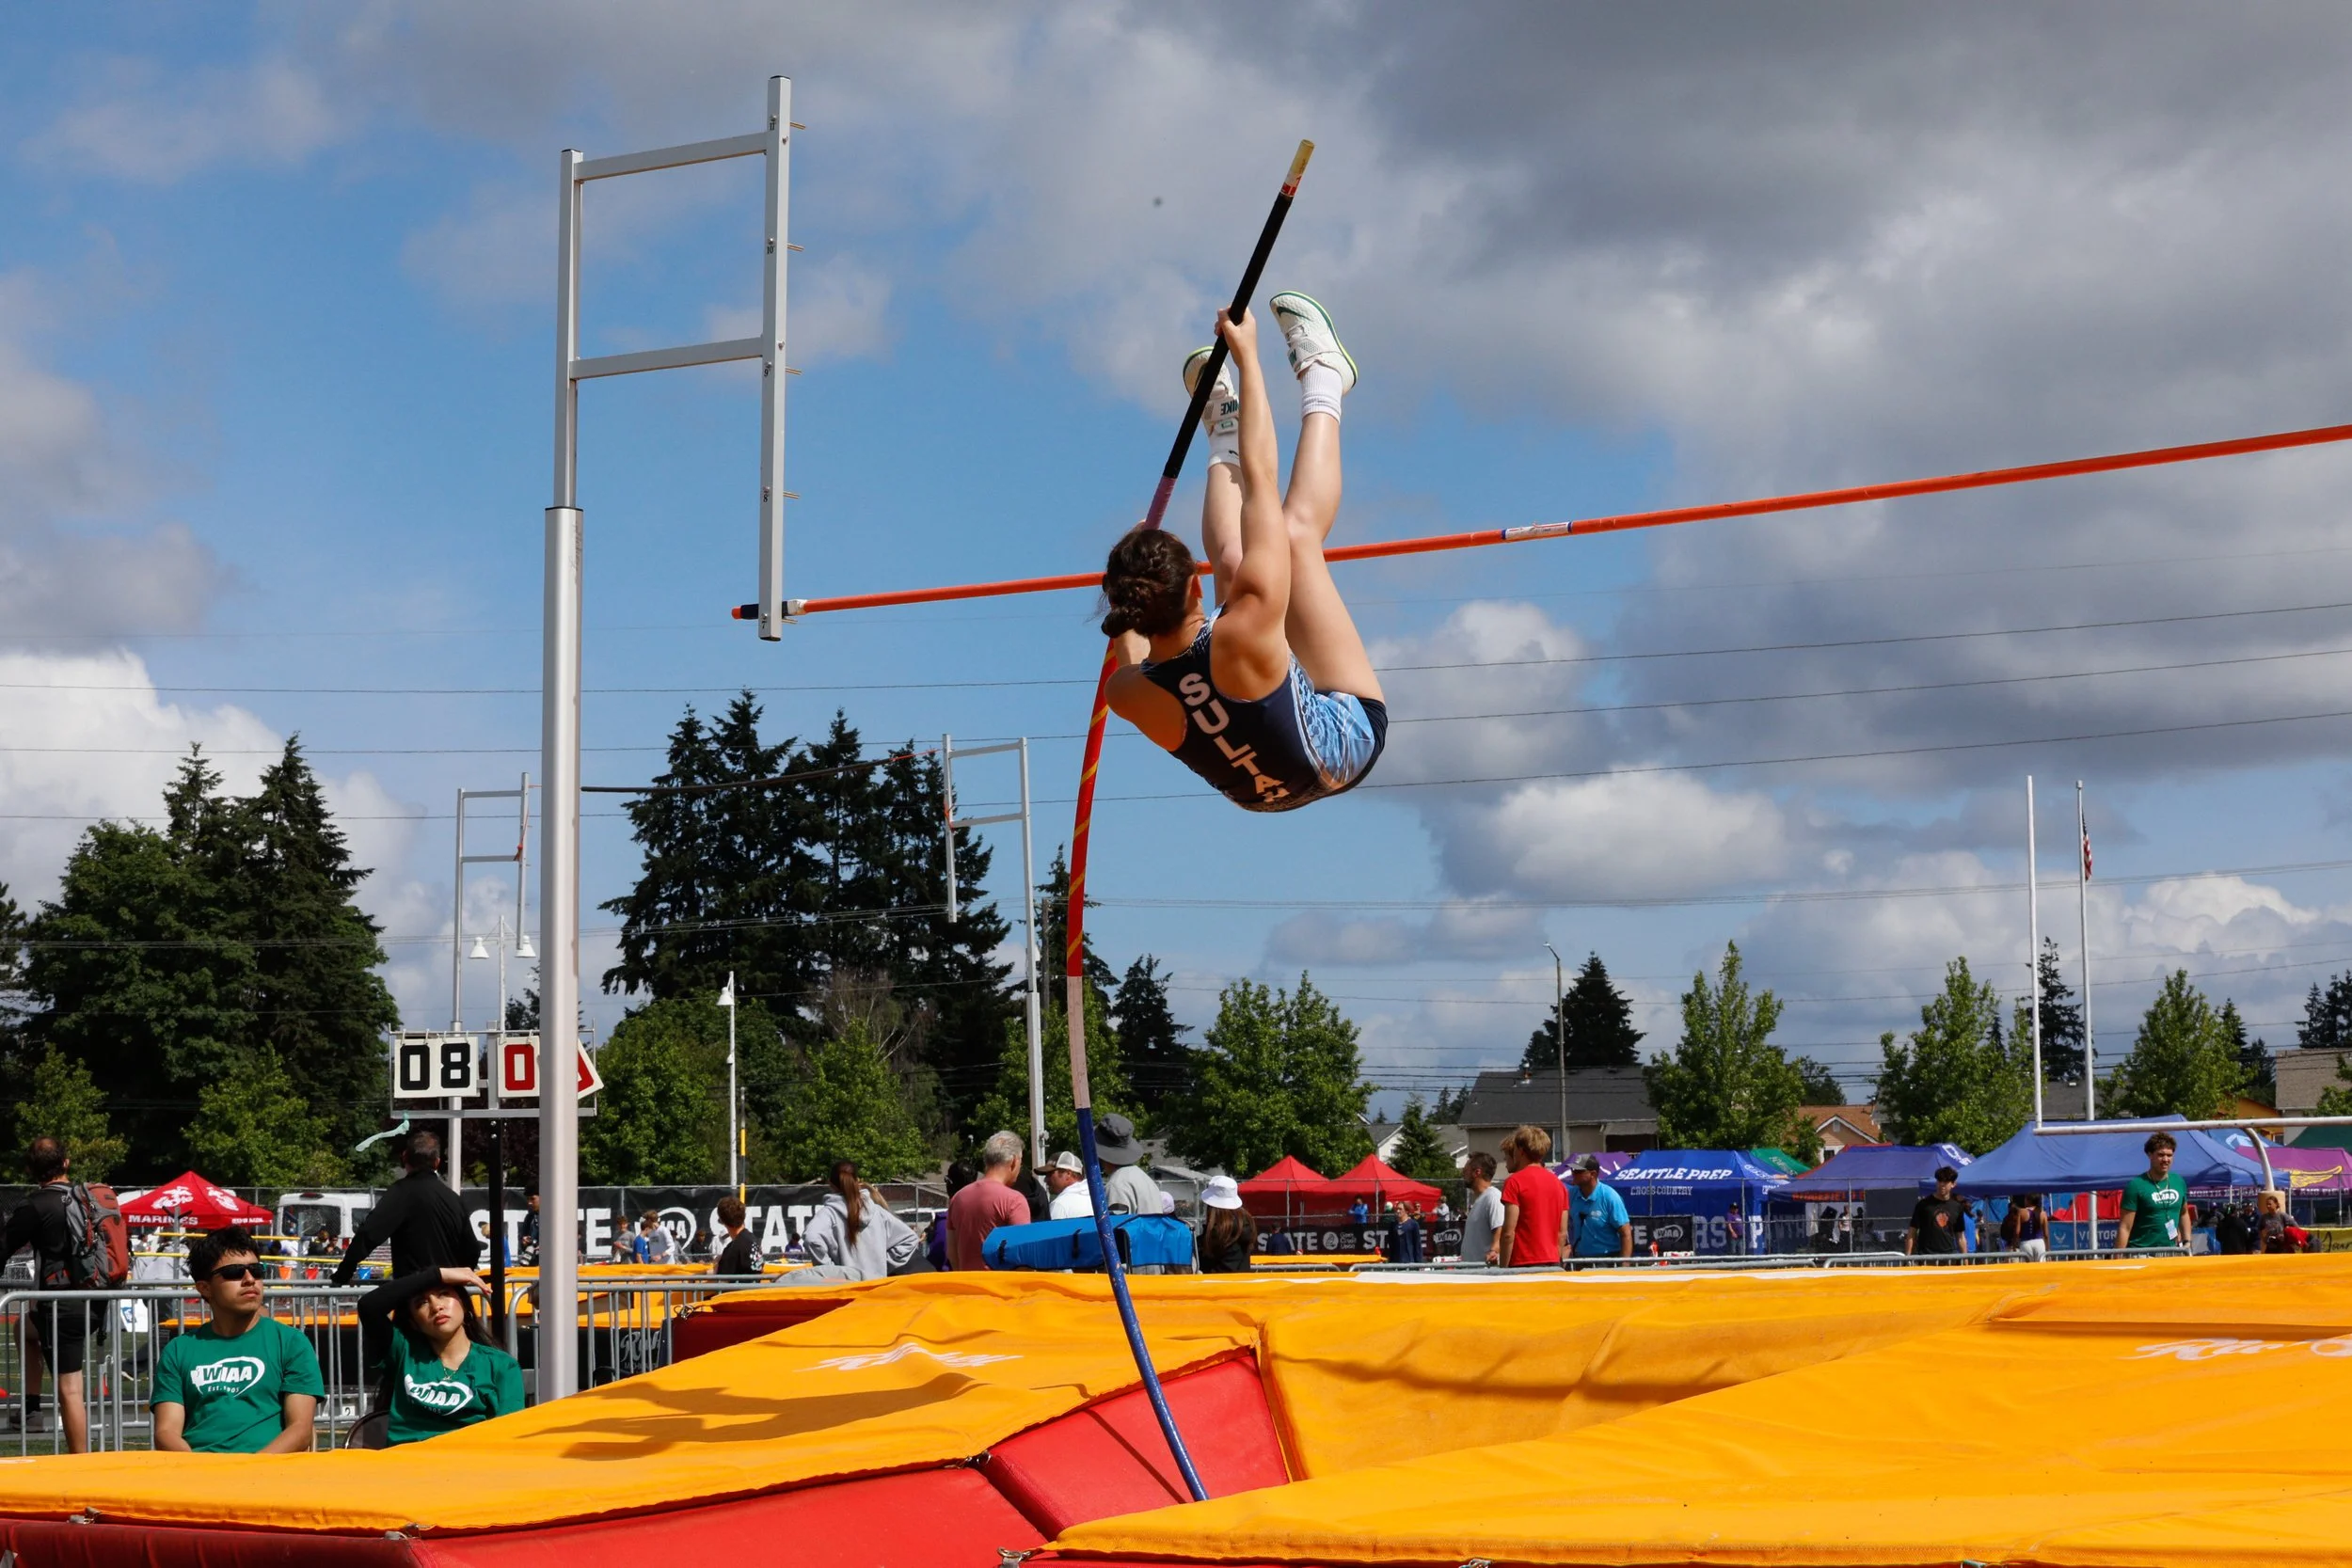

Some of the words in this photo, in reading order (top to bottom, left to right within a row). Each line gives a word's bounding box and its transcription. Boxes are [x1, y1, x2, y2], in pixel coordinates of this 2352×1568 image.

[400, 1042, 470, 1091] 08
[1614, 1168, 1684, 1180] SEATTLE
[1685, 1169, 1733, 1180] PREP
[1656, 1186, 1693, 1196] COUNTRY
[202, 1365, 253, 1384] WIAA
